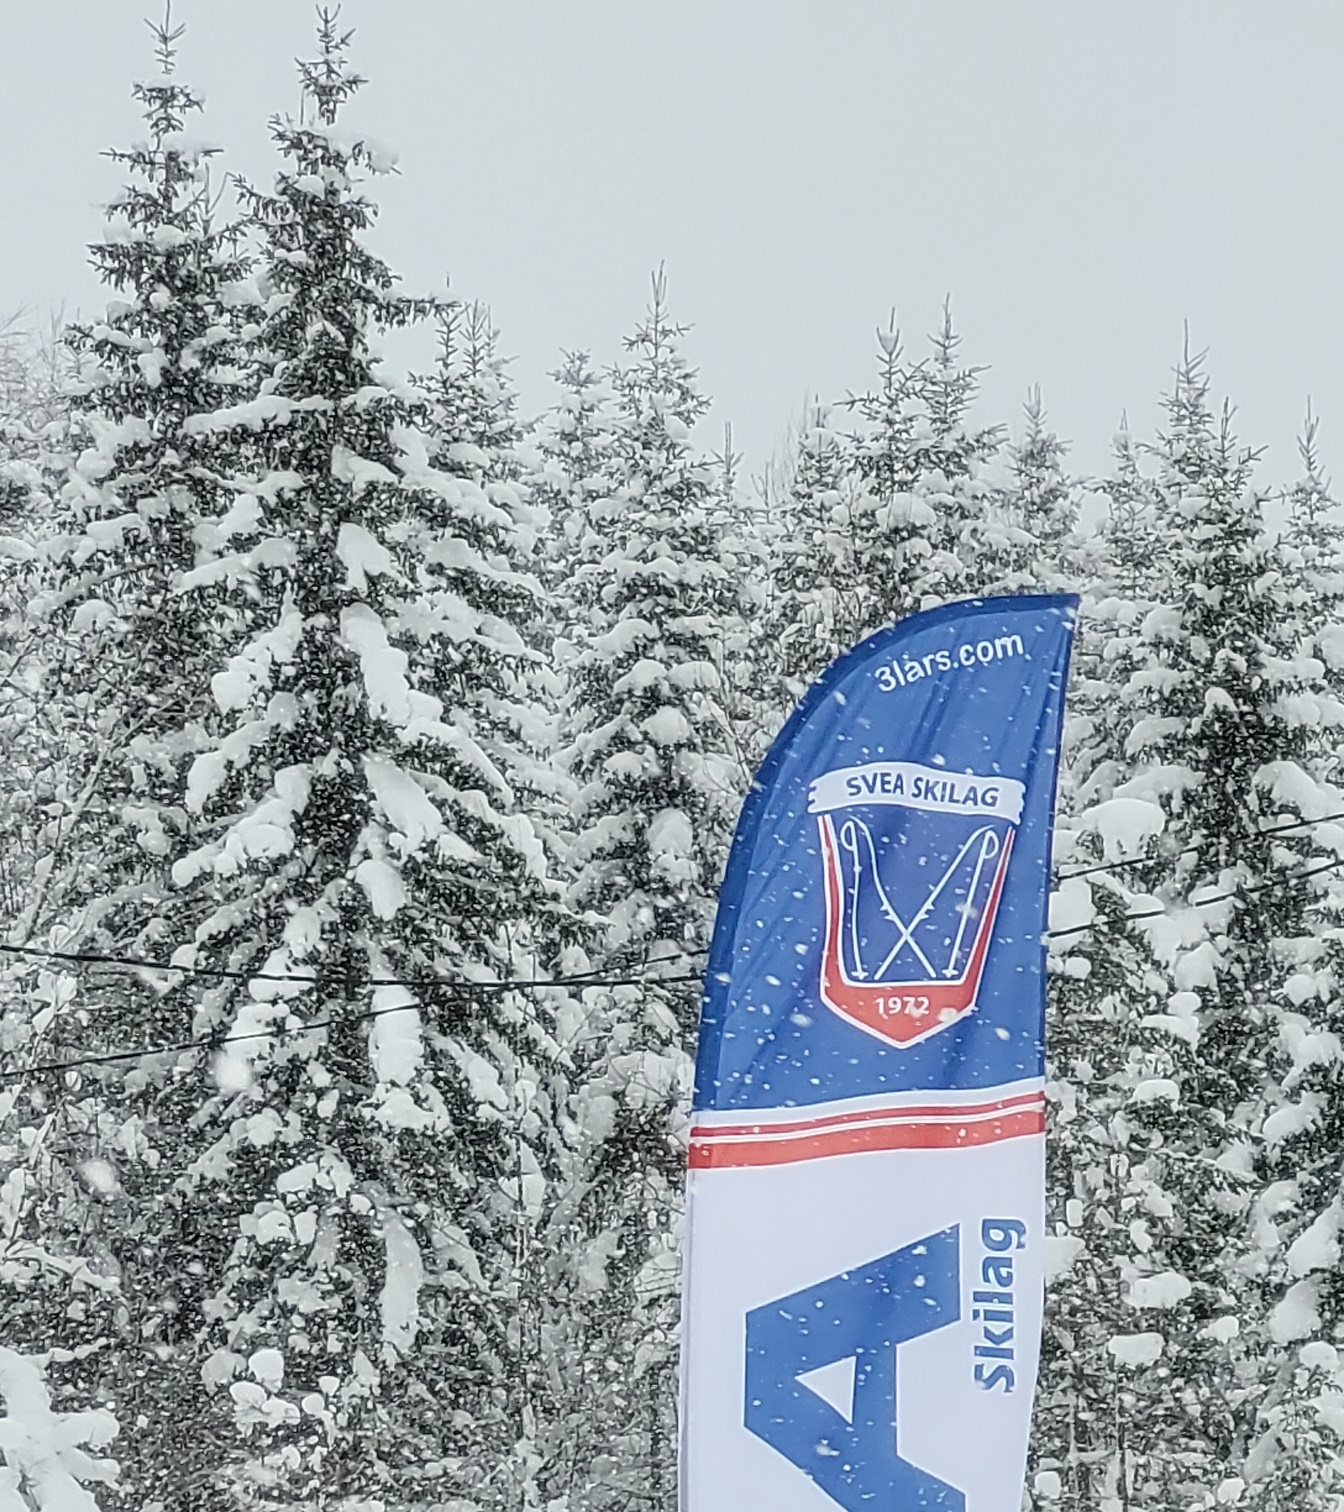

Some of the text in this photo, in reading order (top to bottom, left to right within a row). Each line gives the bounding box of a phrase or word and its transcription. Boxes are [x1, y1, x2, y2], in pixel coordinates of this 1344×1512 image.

[874, 630, 1025, 692] 3lars.com
[845, 771, 1001, 808] SVEA SKILAG
[873, 996, 931, 1017] 1972
[972, 1216, 1027, 1394] Skilag
